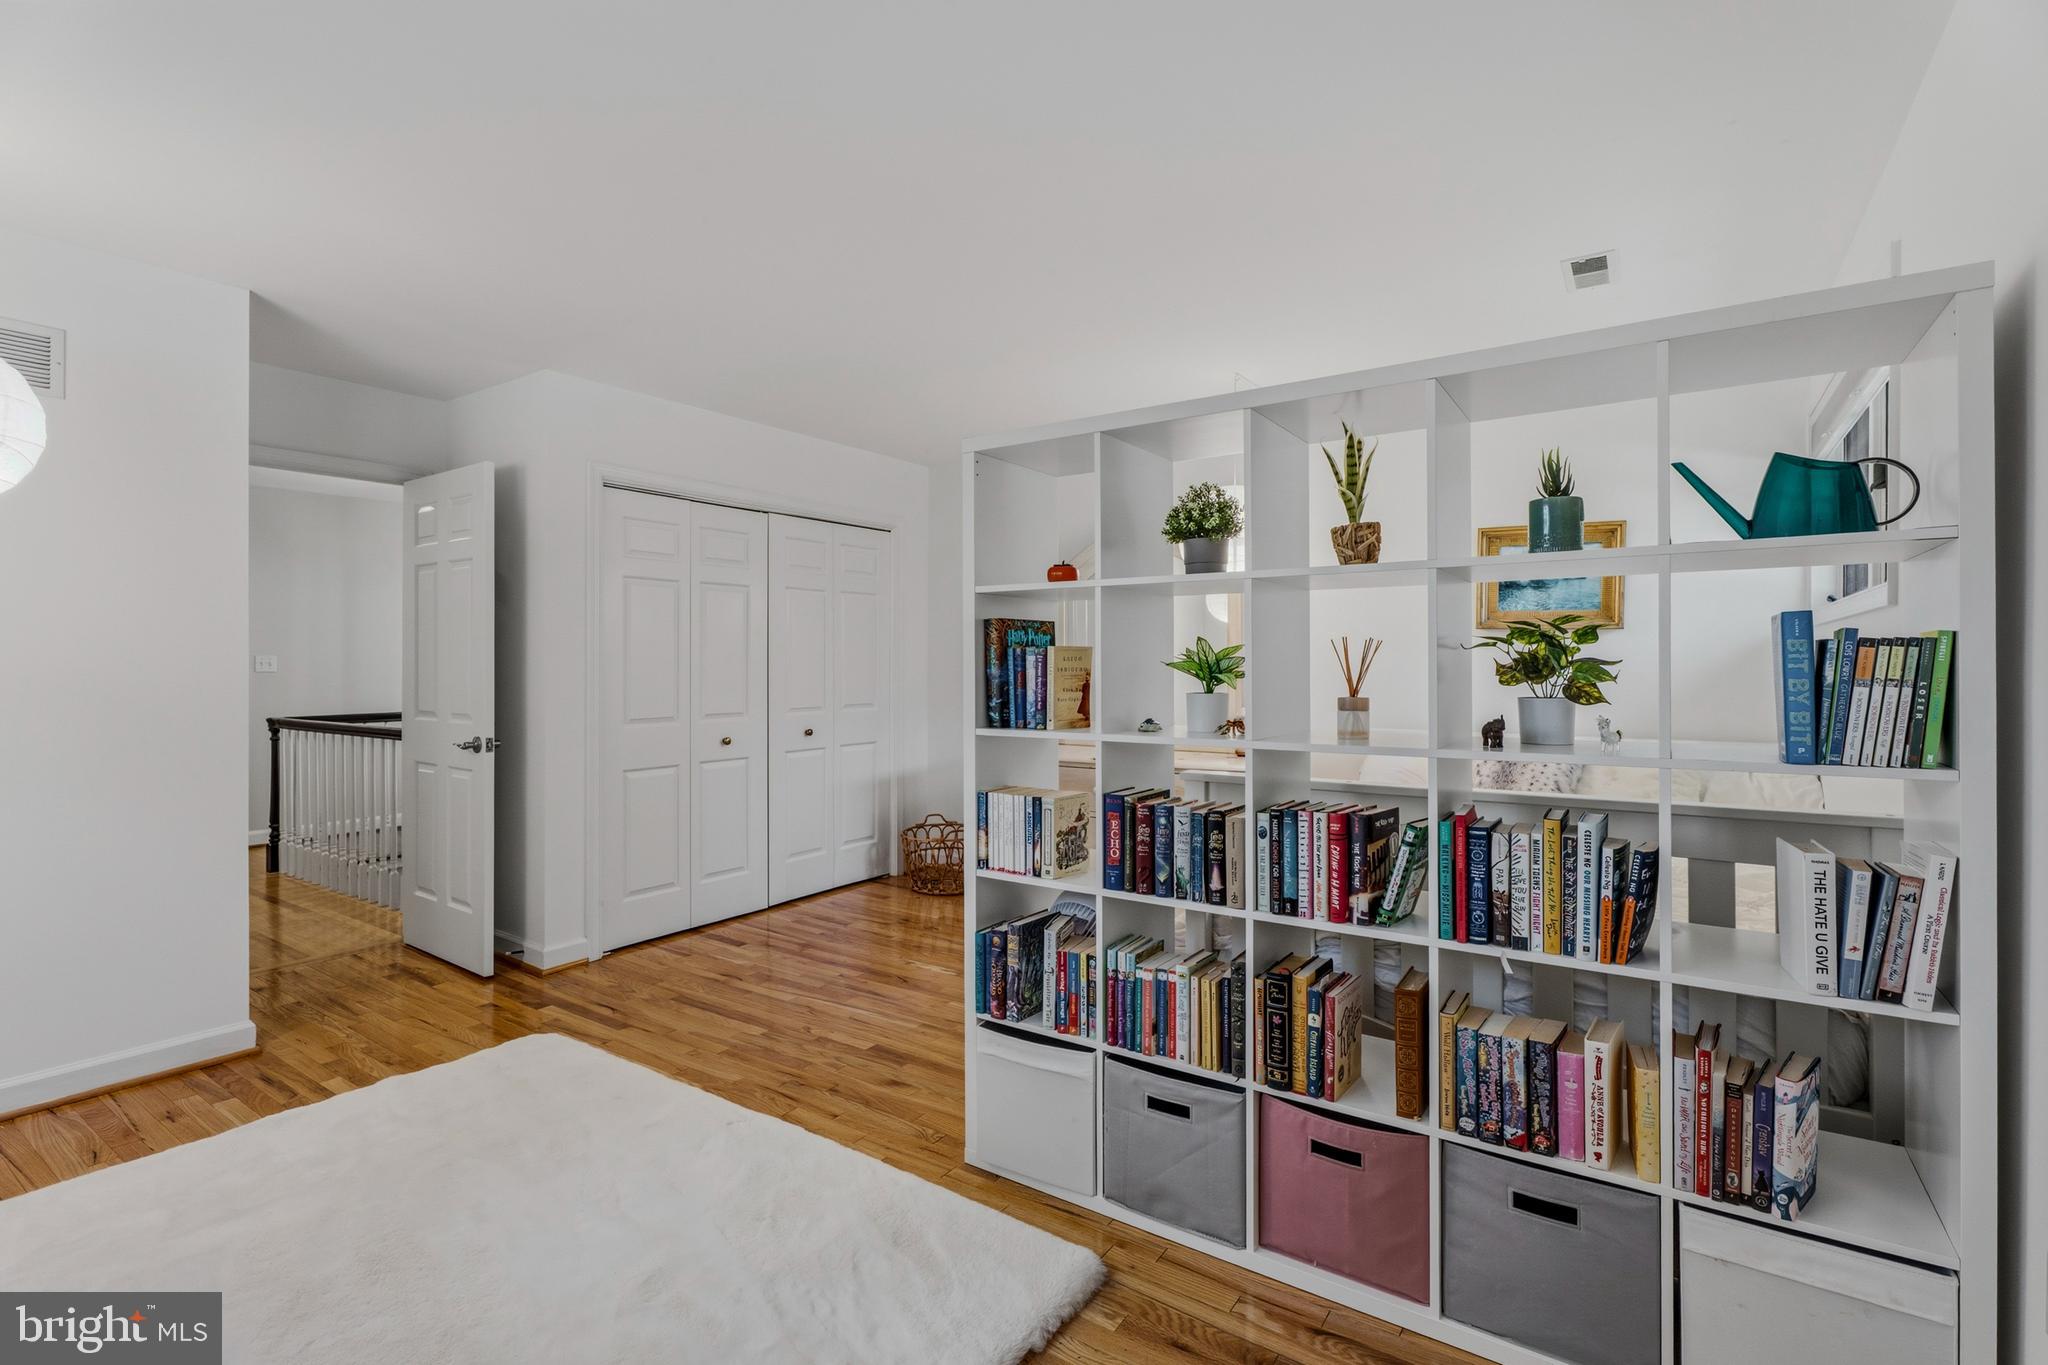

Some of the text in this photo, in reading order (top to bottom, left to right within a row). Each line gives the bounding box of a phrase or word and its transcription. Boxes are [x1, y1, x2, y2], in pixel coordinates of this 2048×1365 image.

[1028, 628, 1051, 648] Potter
[1844, 641, 1853, 655] LOIS
[1841, 658, 1851, 681] LOWRY
[1787, 639, 1812, 746] BIT BY BIT
[1915, 681, 1927, 719] LOSER
[1110, 820, 1120, 858] ECHO
[1331, 845, 1340, 870] CRYING
[1604, 855, 1612, 879] Celeste
[1330, 879, 1339, 887] H
[1496, 868, 1504, 885] PAX
[1565, 872, 1574, 885] SKY
[1603, 880, 1611, 890] Ng
[1629, 854, 1641, 893] CELESTE NG
[1814, 870, 1827, 894] THE
[1331, 887, 1340, 910] MART
[1532, 839, 1541, 935] MIRIAM TOEWS FIGHT NIGHT
[1583, 830, 1592, 944] CELESTE NG OUR MISSING HEARTS
[1936, 887, 1948, 913] Classical
[1814, 898, 1828, 929] HATE
[1934, 913, 1944, 928] Logic
[1815, 933, 1828, 942] U
[1924, 920, 1932, 935] First
[1932, 928, 1940, 940] and
[1921, 935, 1931, 954] Course
[1815, 946, 1829, 975] GIVE
[1309, 1058, 1318, 1081] ISLAND
[1443, 1049, 1451, 1073] Hollow
[1596, 1085, 1604, 1106] ANNE
[1700, 1098, 1708, 1138] NOTORIOUS
[1596, 1114, 1604, 1147] AVONLEA
[1755, 1123, 1771, 1157] Crenshaw
[1786, 1135, 1794, 1154] Secret
